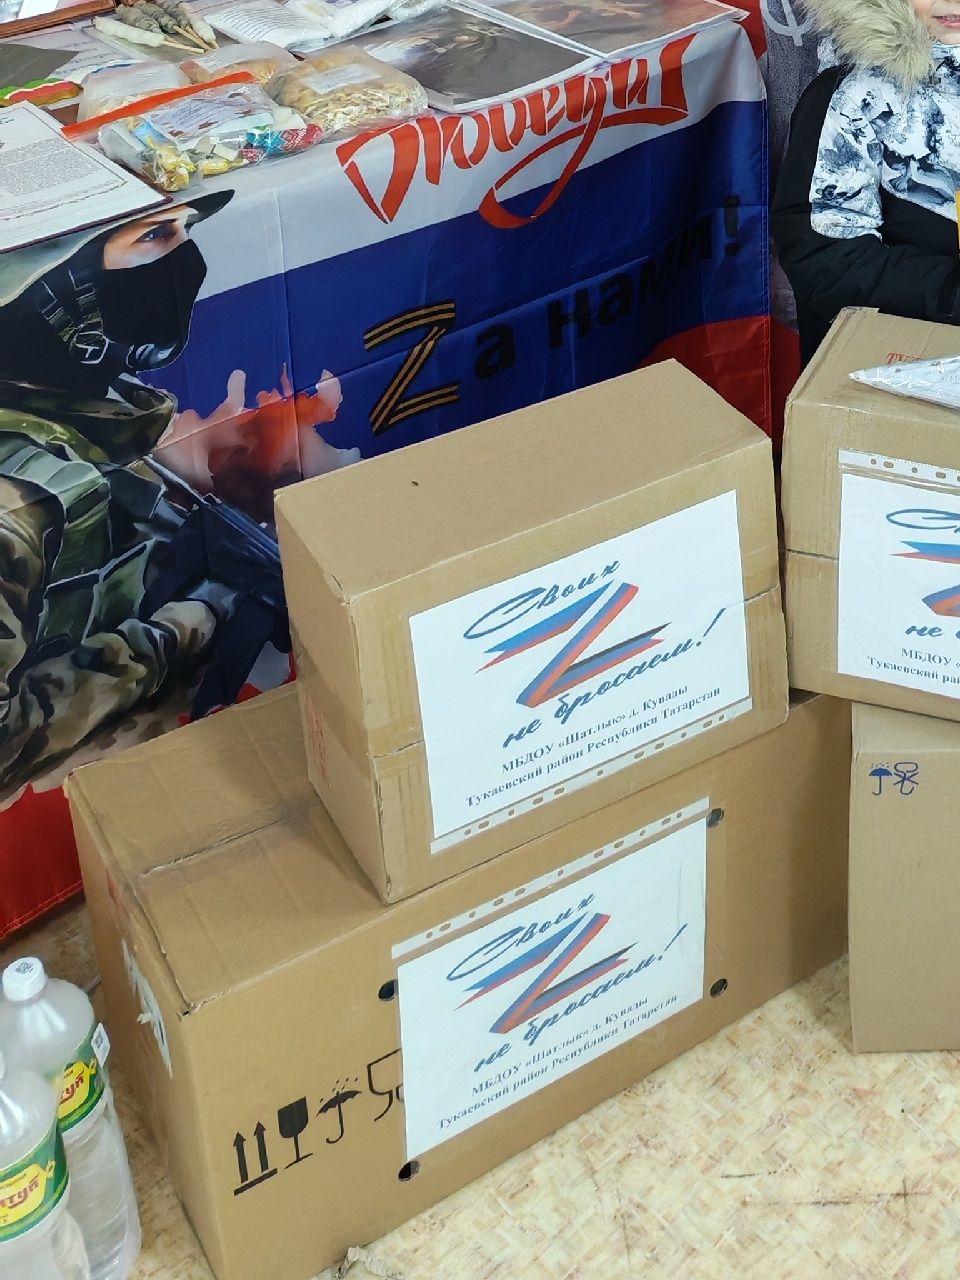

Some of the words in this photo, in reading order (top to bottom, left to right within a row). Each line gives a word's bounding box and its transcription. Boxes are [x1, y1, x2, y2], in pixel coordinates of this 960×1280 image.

[463, 560, 619, 640] Своих
[905, 624, 944, 637] не
[502, 719, 542, 748] не
[554, 607, 726, 724] бросаем!
[867, 656, 938, 680] Тукаевский
[901, 648, 951, 666] МБДОУ
[465, 767, 543, 807] Тукаевский
[547, 750, 583, 774] район
[587, 717, 658, 753] Республики
[660, 688, 720, 720] Татарстан
[501, 744, 554, 774] МБДОУ
[558, 714, 626, 748] «Шатлык»
[446, 893, 596, 981] Своих
[473, 1042, 512, 1072] не
[523, 924, 687, 1046] бросаем!
[472, 1063, 522, 1097] МБДОУ
